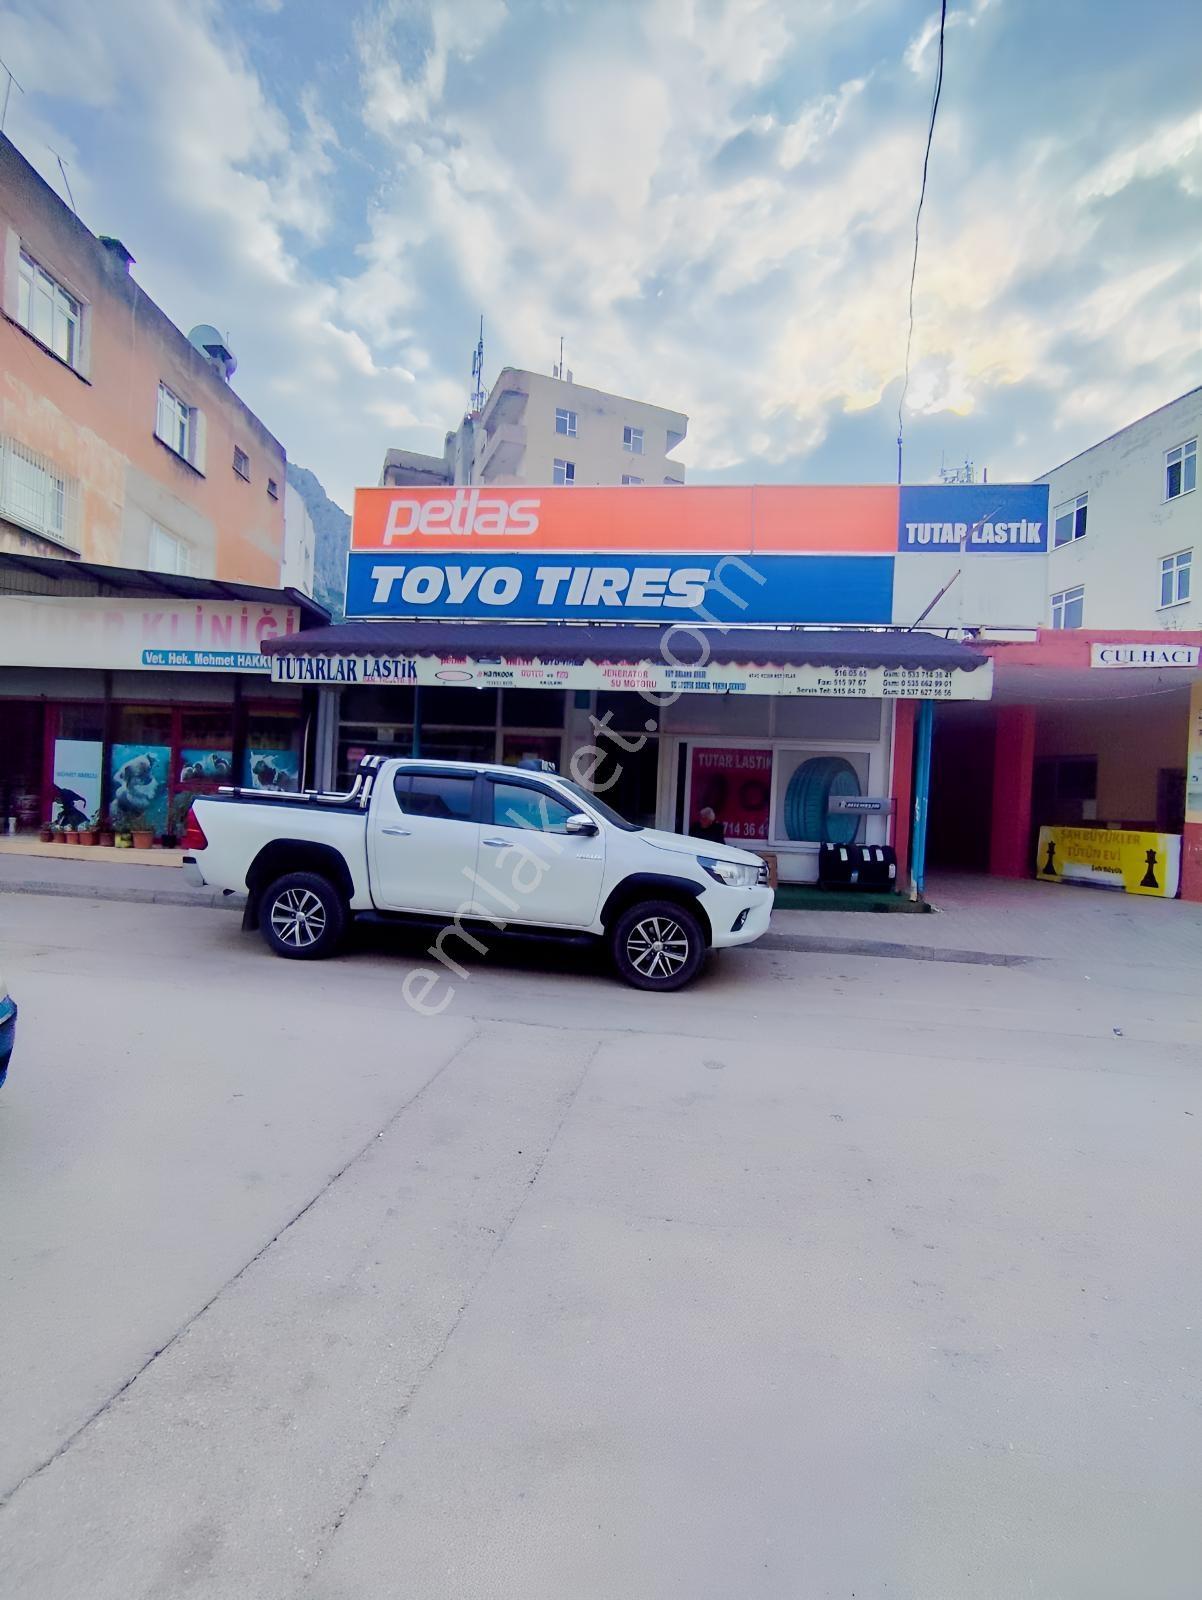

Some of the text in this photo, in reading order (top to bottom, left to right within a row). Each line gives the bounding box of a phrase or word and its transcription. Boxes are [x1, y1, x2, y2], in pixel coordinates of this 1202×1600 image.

[382, 489, 541, 545] petlas
[371, 565, 711, 608] TOYO TIRES
[145, 651, 166, 664] Vet.
[195, 653, 234, 666] Mehmet
[276, 657, 357, 682] TUTARLAR
[698, 753, 733, 768] TUTAR
